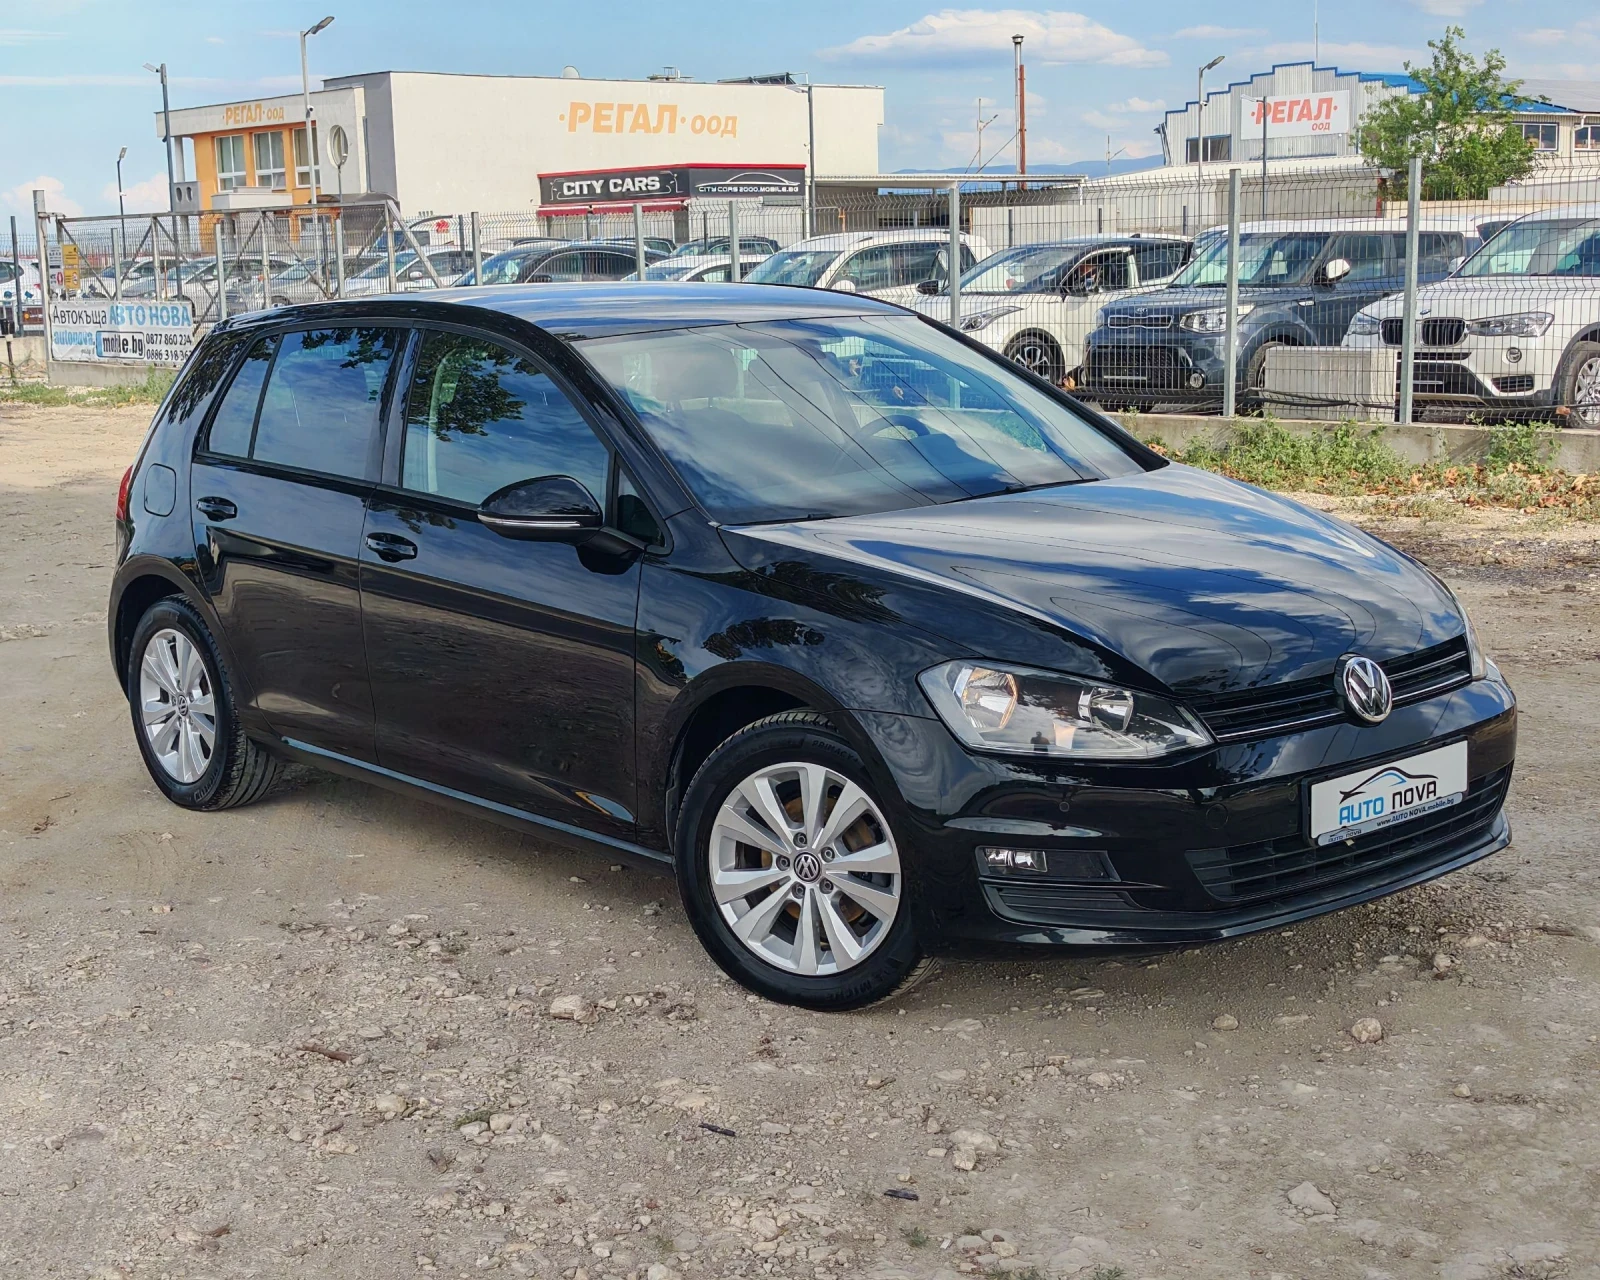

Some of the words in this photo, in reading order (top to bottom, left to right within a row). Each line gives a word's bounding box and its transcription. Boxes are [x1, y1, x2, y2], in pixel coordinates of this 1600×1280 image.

[225, 103, 262, 125] РЕГАЛ
[568, 101, 678, 133] РЕГАЛ
[1255, 97, 1333, 125] РЕГАЛ
[563, 180, 608, 196] CITY
[609, 175, 661, 193] CARS
[53, 305, 107, 328] Автокъща
[109, 303, 146, 326] АВТО
[150, 304, 192, 327] НОВА
[164, 333, 178, 346] 860
[1338, 796, 1385, 826] AUTO
